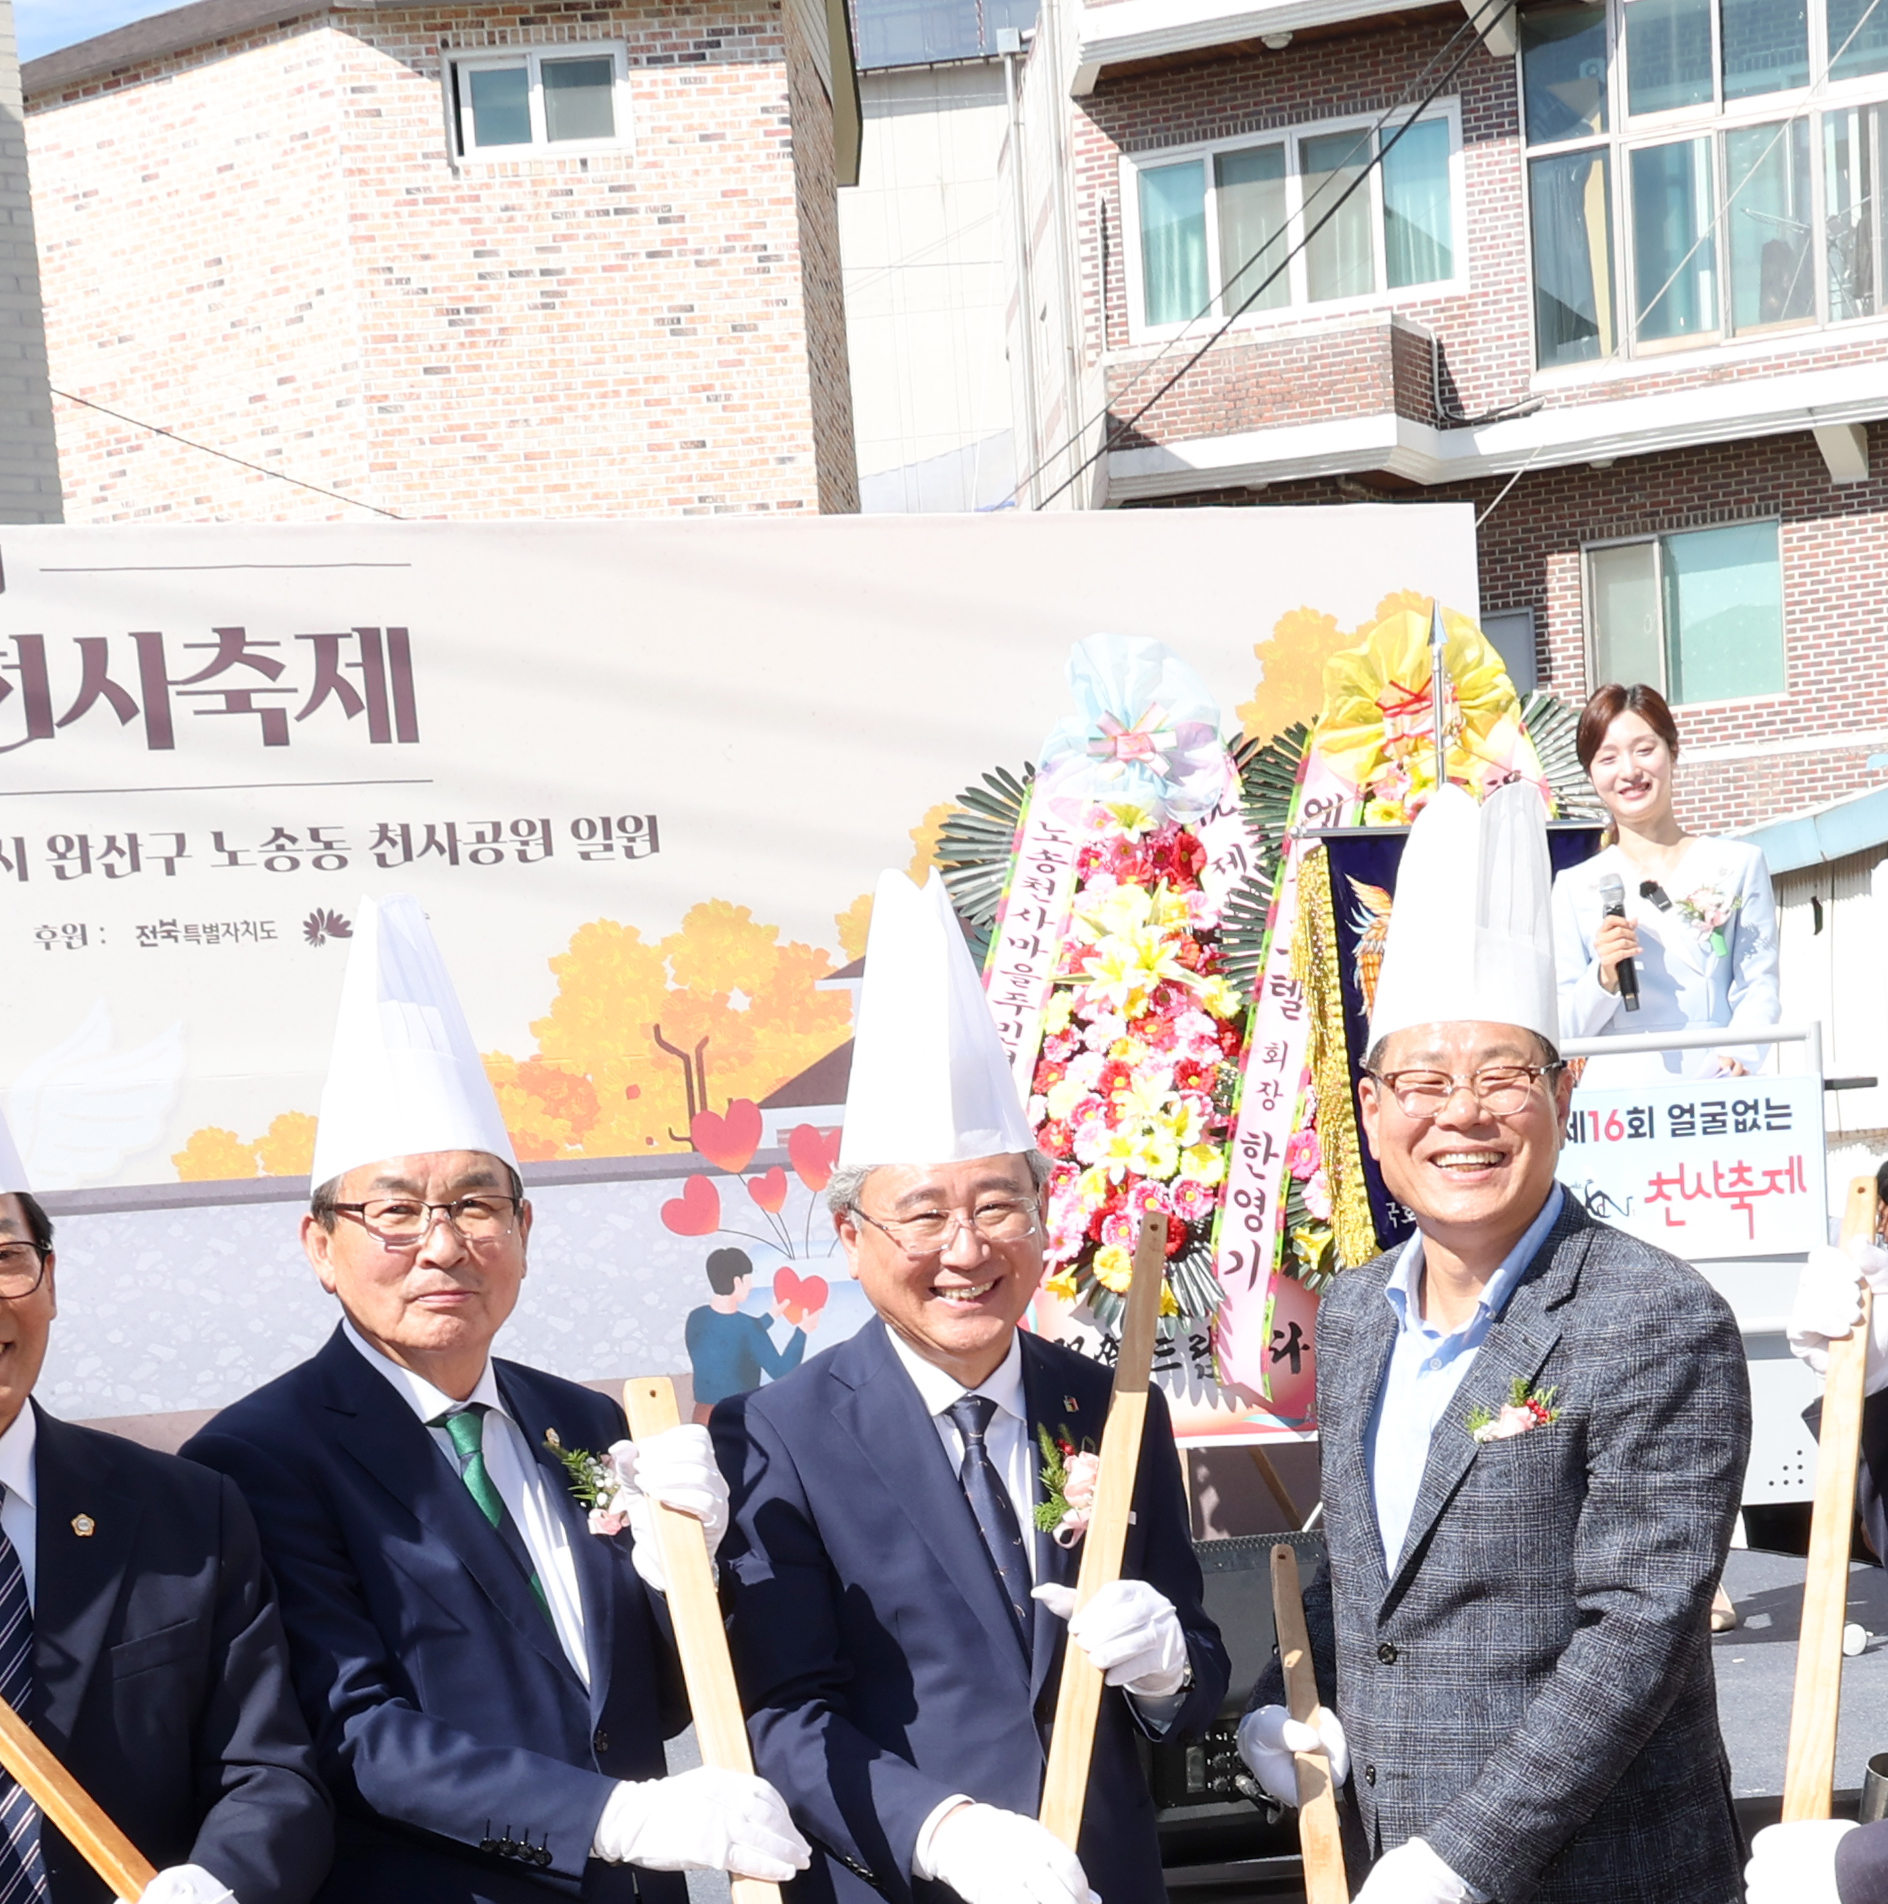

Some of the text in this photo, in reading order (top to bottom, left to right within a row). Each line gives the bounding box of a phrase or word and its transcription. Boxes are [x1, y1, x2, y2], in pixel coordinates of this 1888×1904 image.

[45, 833, 193, 880] 완산구
[210, 825, 352, 874] 노송동
[369, 816, 553, 869] 천사공원
[570, 812, 661, 861] 일원
[135, 917, 279, 948] 전북특별자치도
[993, 820, 1073, 1070] 노송천사마을주민
[1667, 1097, 1793, 1138] 얼굴없는
[1223, 1130, 1281, 1292] 한영기
[1644, 1154, 1807, 1240] 천사축제
